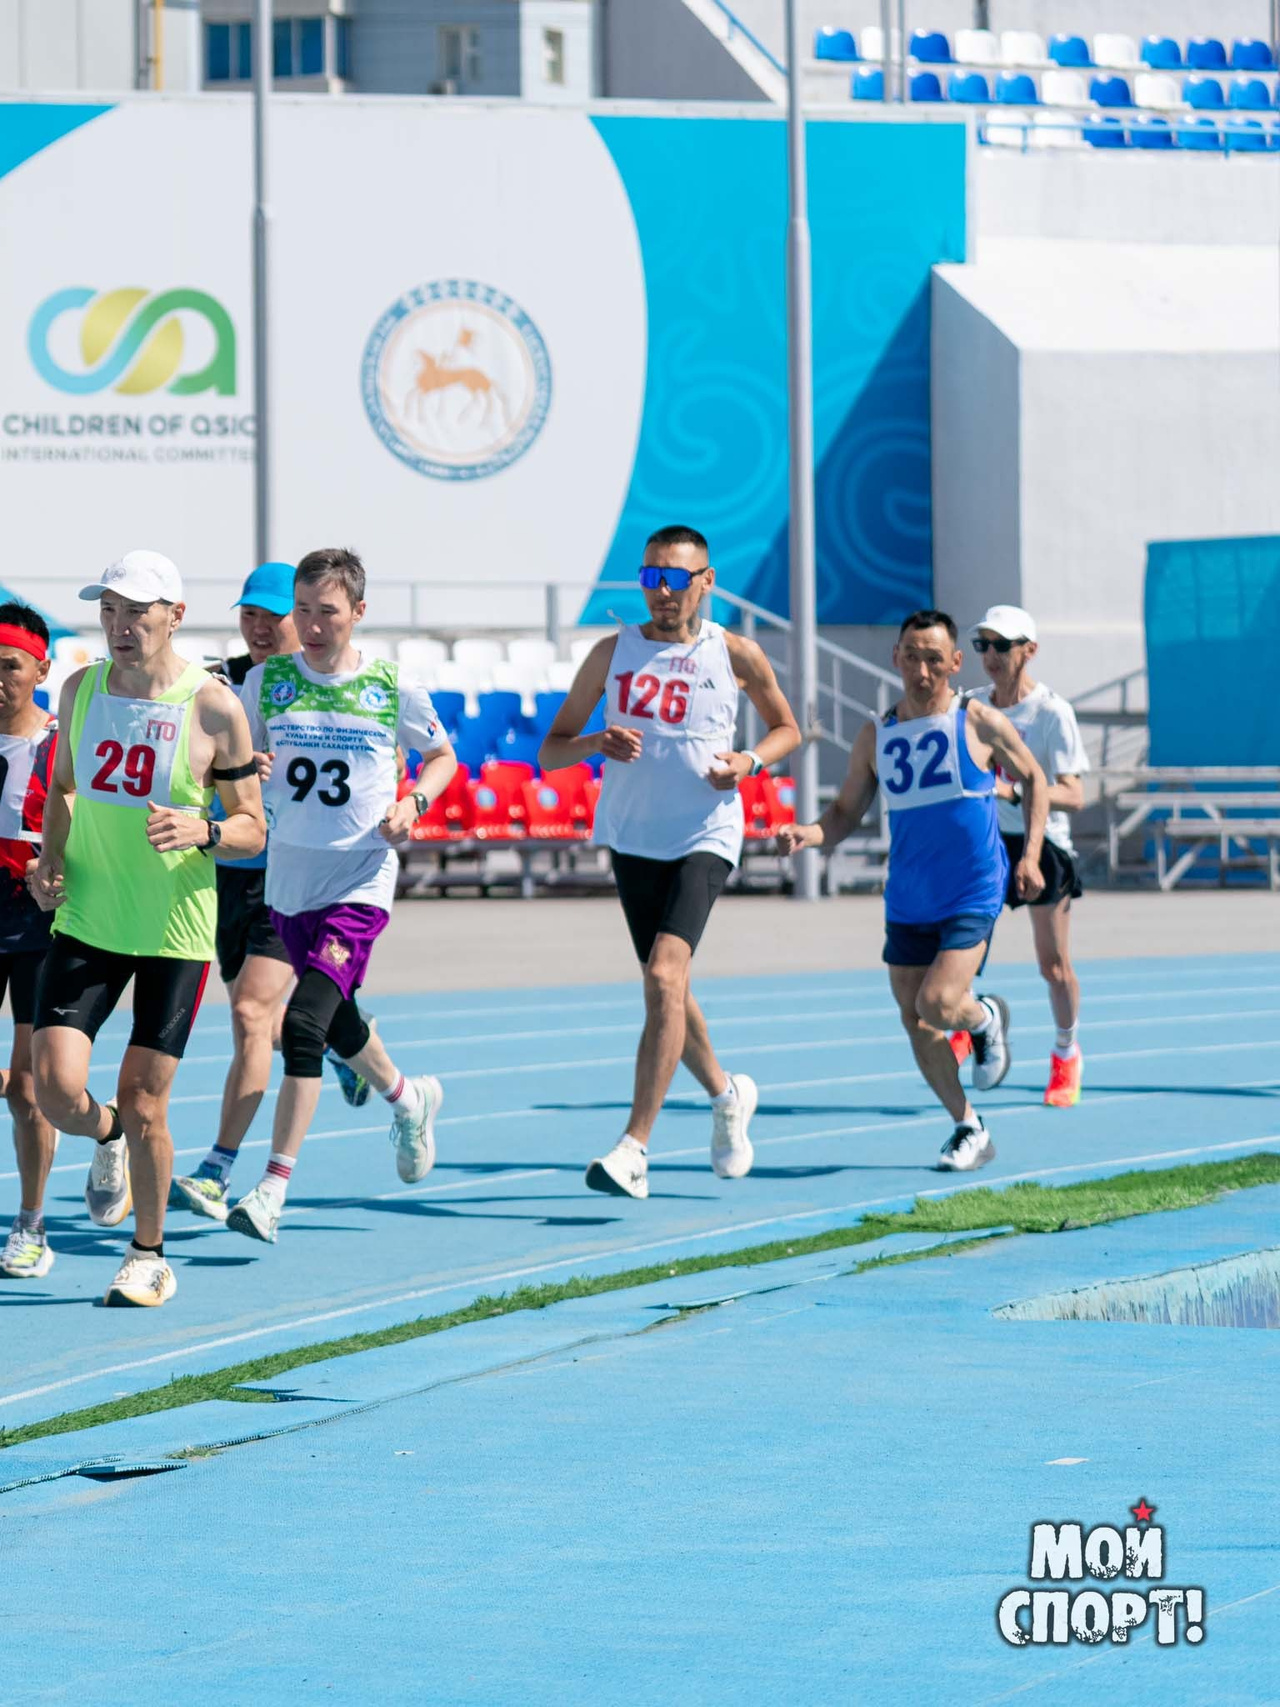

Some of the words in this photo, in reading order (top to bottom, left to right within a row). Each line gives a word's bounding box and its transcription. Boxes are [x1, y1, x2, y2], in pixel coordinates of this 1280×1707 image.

[2, 413, 141, 437] CHILDREN
[148, 414, 184, 437] OF
[1, 446, 148, 462] INTERNATIONAL
[154, 447, 256, 462] COMMITTE
[614, 670, 690, 725] 126
[145, 718, 177, 742] ГТО
[322, 725, 334, 733] ПО
[331, 735, 363, 743] СПОРТУ
[91, 740, 156, 797] 29
[883, 730, 952, 795] 32
[286, 756, 351, 807] 93
